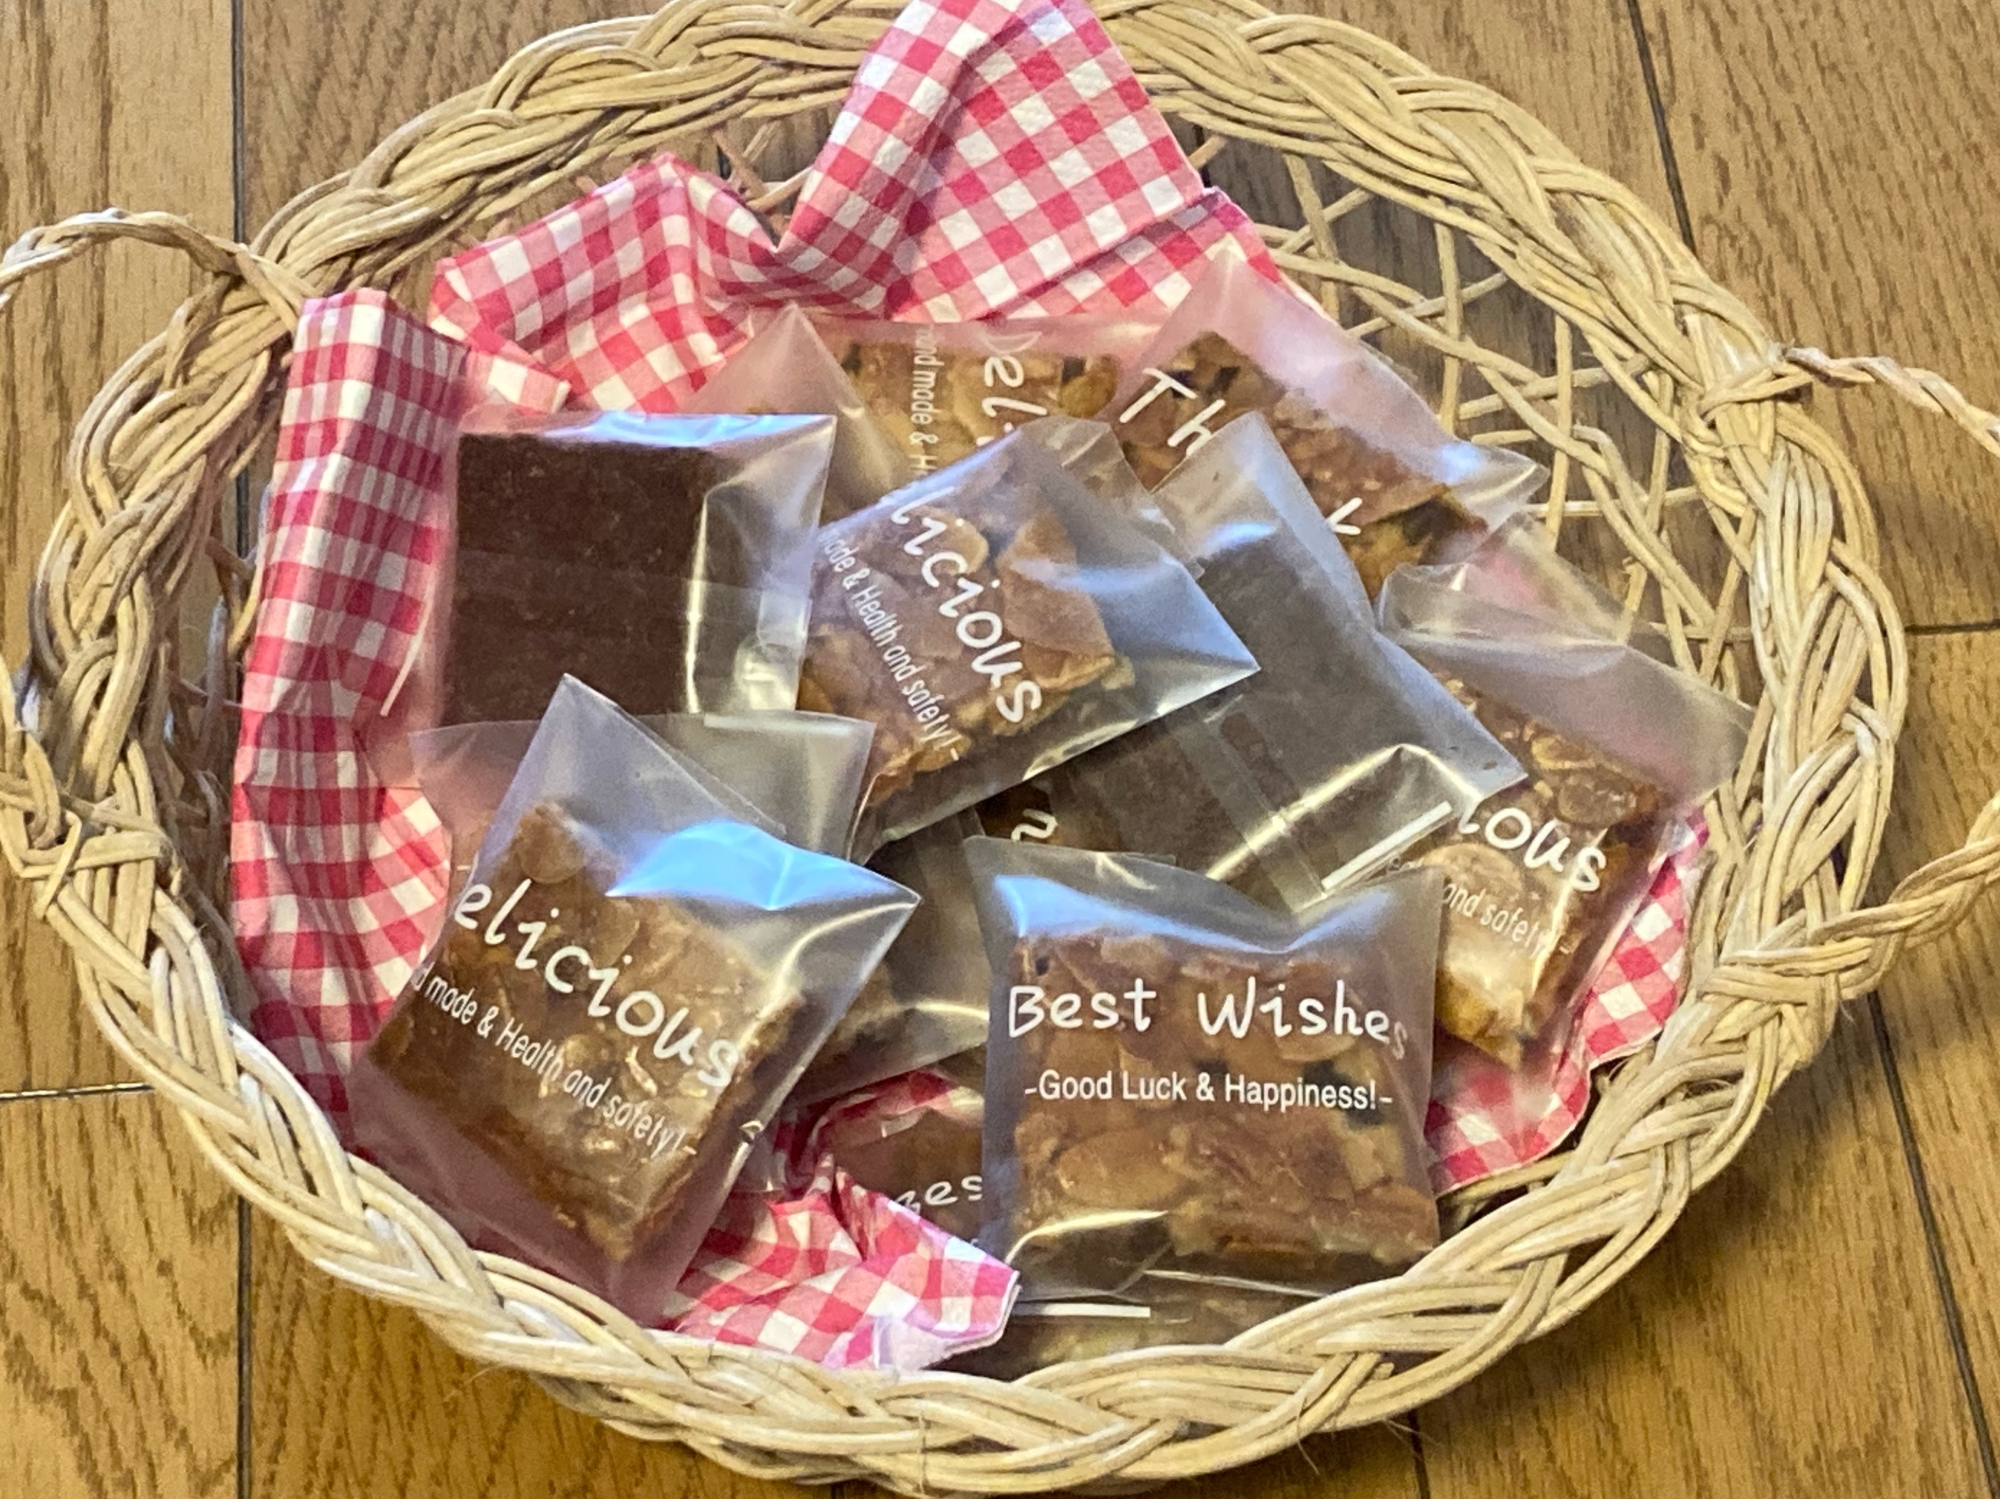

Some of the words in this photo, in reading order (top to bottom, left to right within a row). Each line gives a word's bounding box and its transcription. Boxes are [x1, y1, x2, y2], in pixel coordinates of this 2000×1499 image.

[842, 568, 870, 591] &
[851, 584, 903, 648] Health
[883, 645, 927, 682] and
[424, 976, 477, 1025] made
[477, 1005, 500, 1039] &
[495, 1017, 564, 1083] Health
[563, 1069, 612, 1109] and
[1008, 978, 1157, 1038] Best
[1198, 976, 1408, 1061] Wishes
[1025, 1069, 1113, 1101] -Good
[1122, 1071, 1188, 1101] Luck
[1195, 1071, 1216, 1101] &
[1225, 1076, 1393, 1112] Happiness!-
